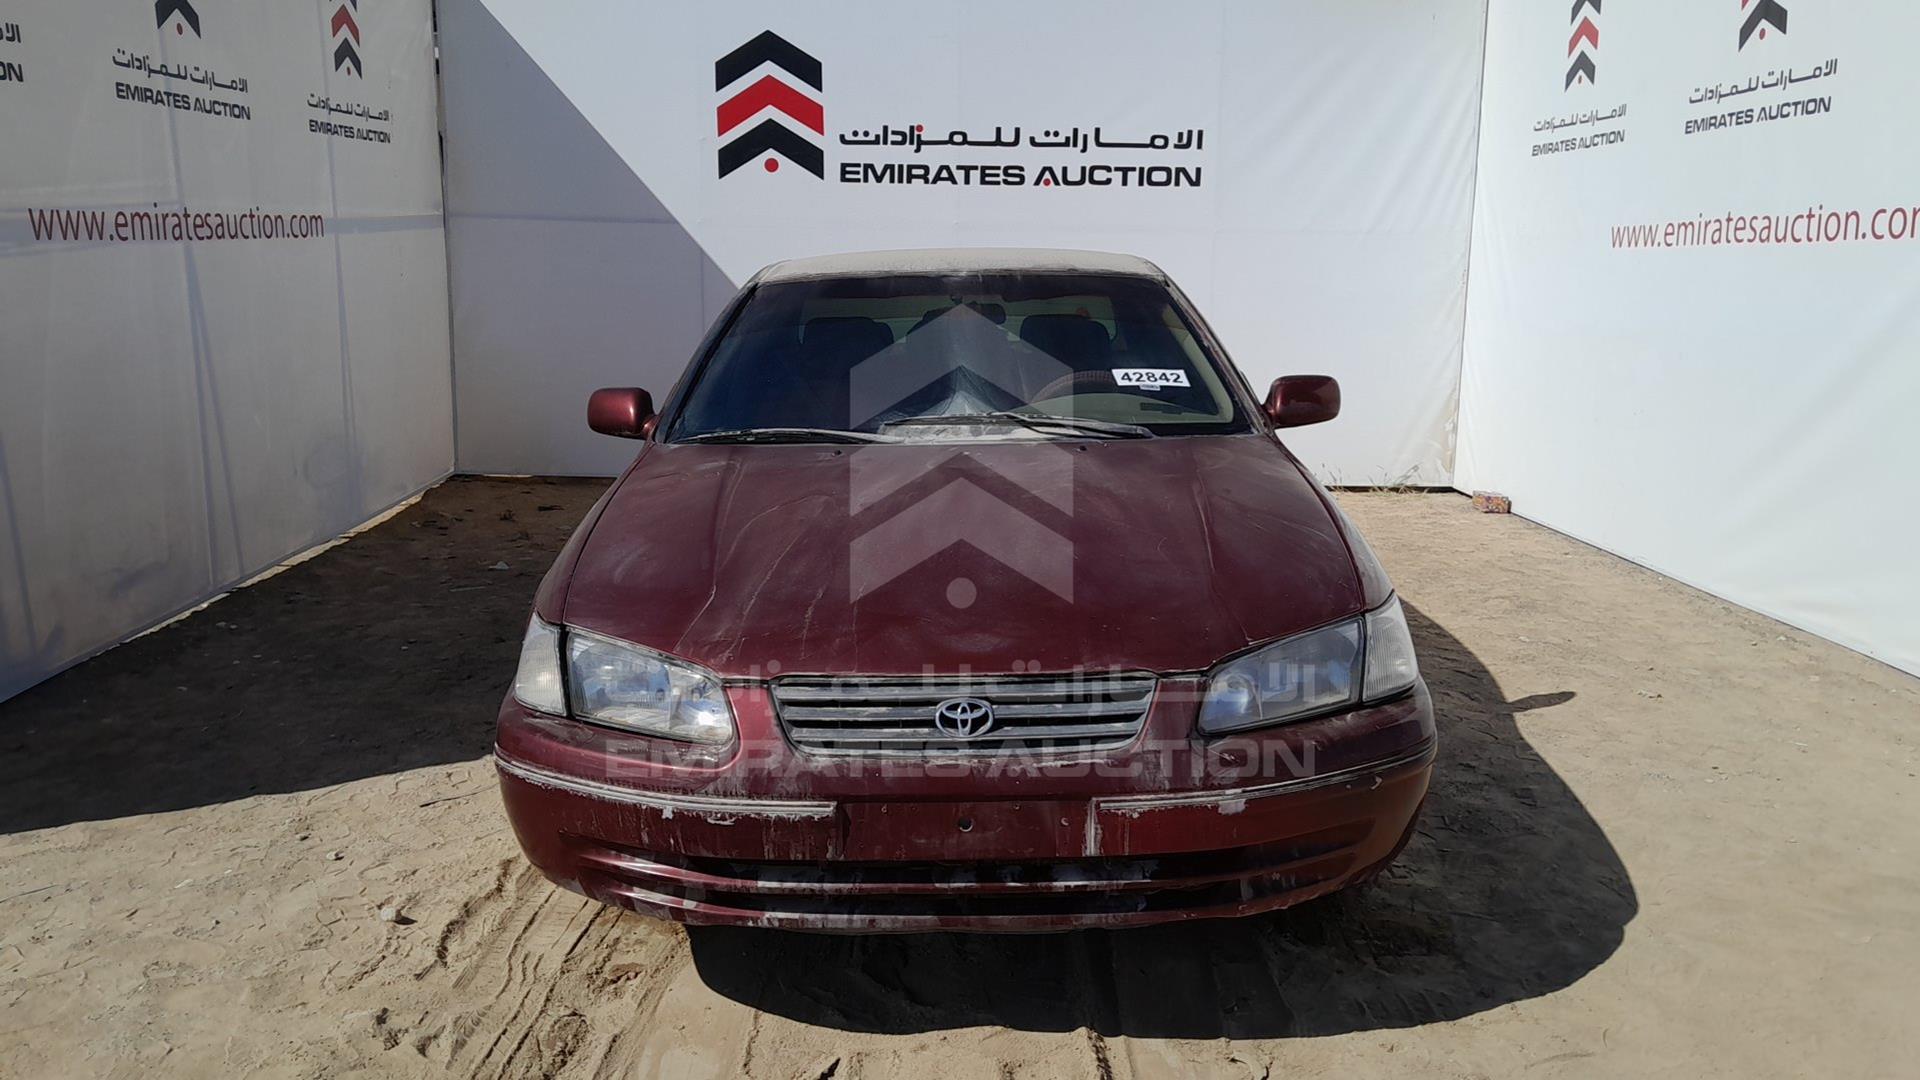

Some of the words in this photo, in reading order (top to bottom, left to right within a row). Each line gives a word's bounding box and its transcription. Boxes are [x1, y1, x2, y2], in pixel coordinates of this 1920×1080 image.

[115, 82, 191, 110] EMIRATES
[193, 97, 251, 120] AUCTION
[1684, 108, 1755, 135] EMIRATES
[1756, 96, 1832, 123] AUCTION
[309, 119, 355, 139] EMIRATES
[356, 128, 391, 144] AUCTION
[1532, 136, 1577, 157] EMIRATES
[1577, 129, 1625, 150] AUCTION
[839, 162, 1026, 187] EMIRATES
[1032, 164, 1202, 188] AUCTION
[28, 203, 325, 242] www.emiratesauction.com
[1121, 371, 1183, 383] 42842
